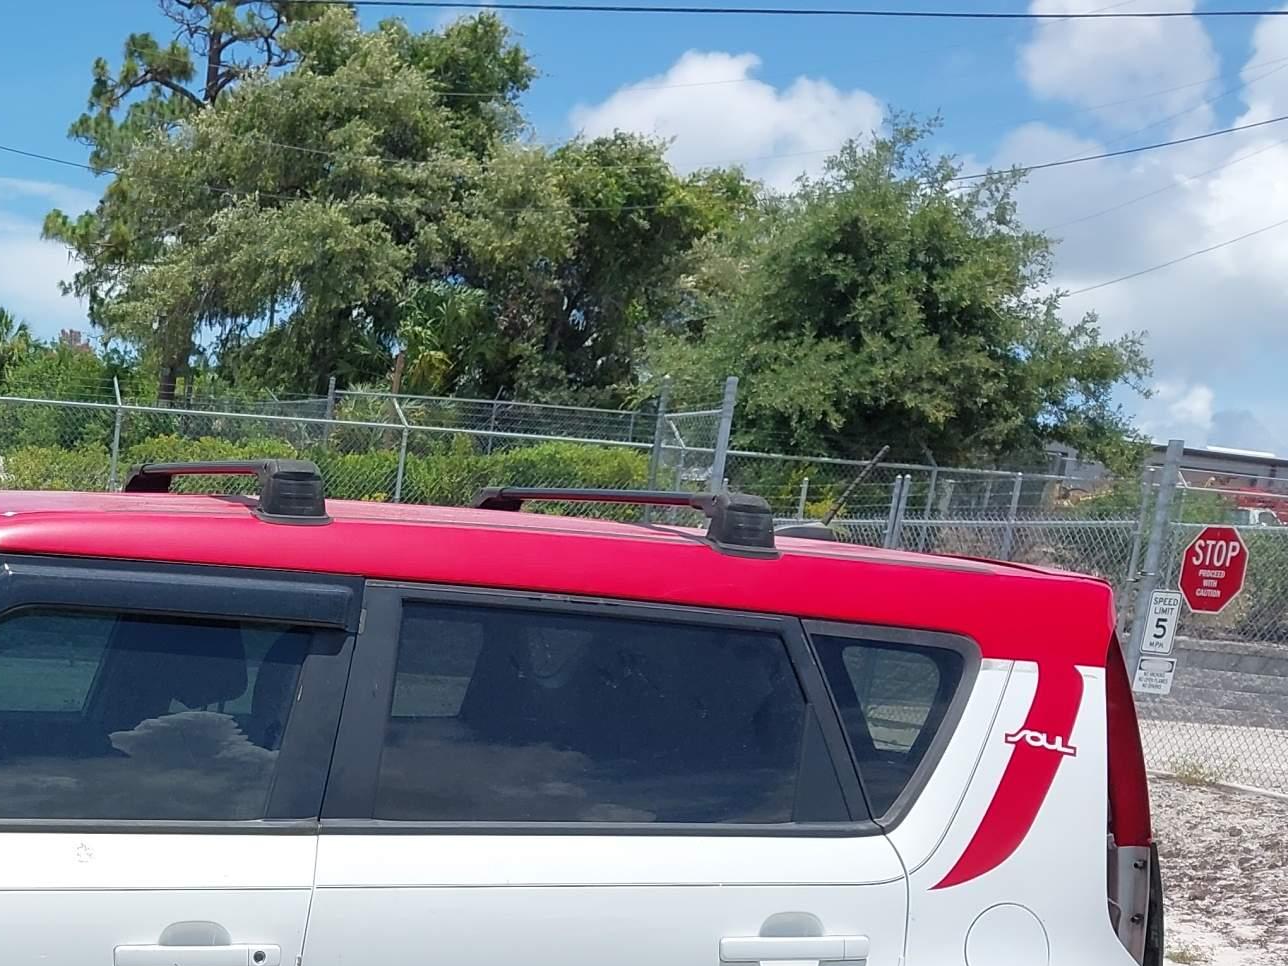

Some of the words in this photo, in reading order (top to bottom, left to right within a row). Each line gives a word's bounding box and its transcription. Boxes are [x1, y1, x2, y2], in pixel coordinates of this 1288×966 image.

[1192, 539, 1241, 567] STOP
[1153, 597, 1179, 606] SPEED
[1154, 607, 1175, 616] LIMIT
[1153, 617, 1168, 639] 5
[1005, 729, 1076, 756] SOUL
